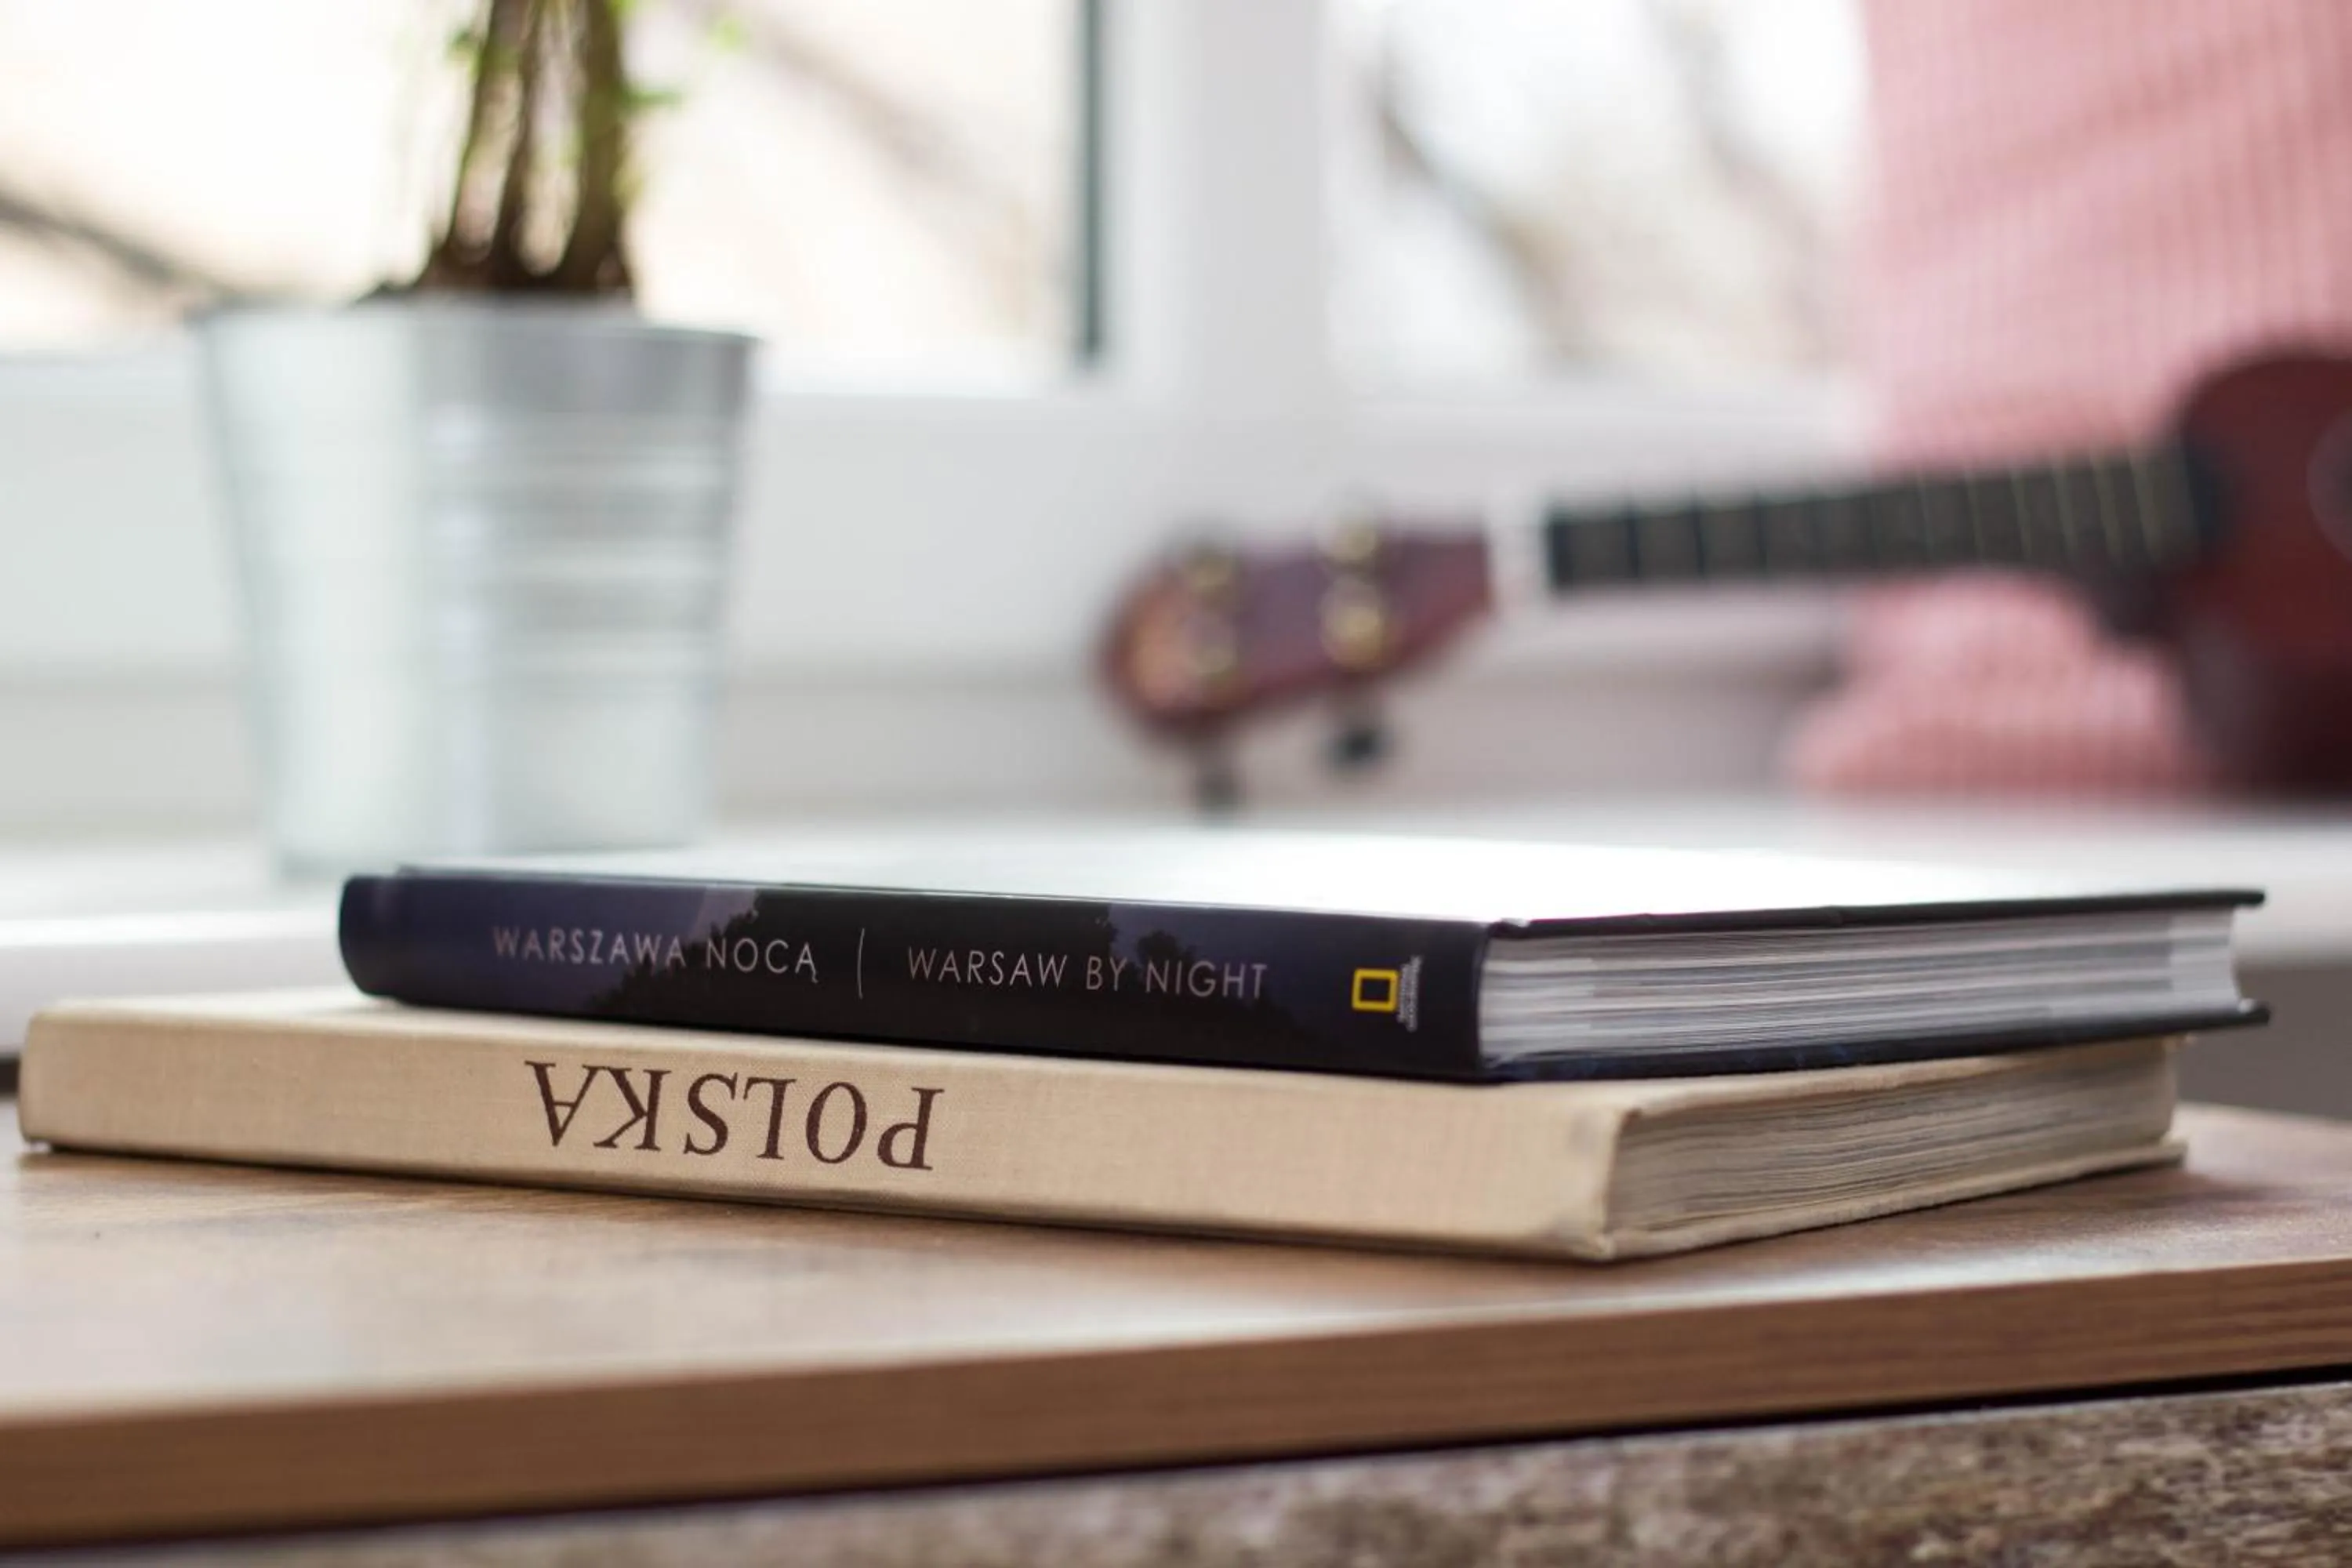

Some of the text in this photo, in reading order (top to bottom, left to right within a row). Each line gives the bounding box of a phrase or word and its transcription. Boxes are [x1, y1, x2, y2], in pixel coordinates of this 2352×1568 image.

[493, 926, 818, 984] WARSZAWA NOCĄ
[908, 946, 1268, 1000] WARSAW BY NIGHT
[524, 1060, 945, 1171] POLSKA
